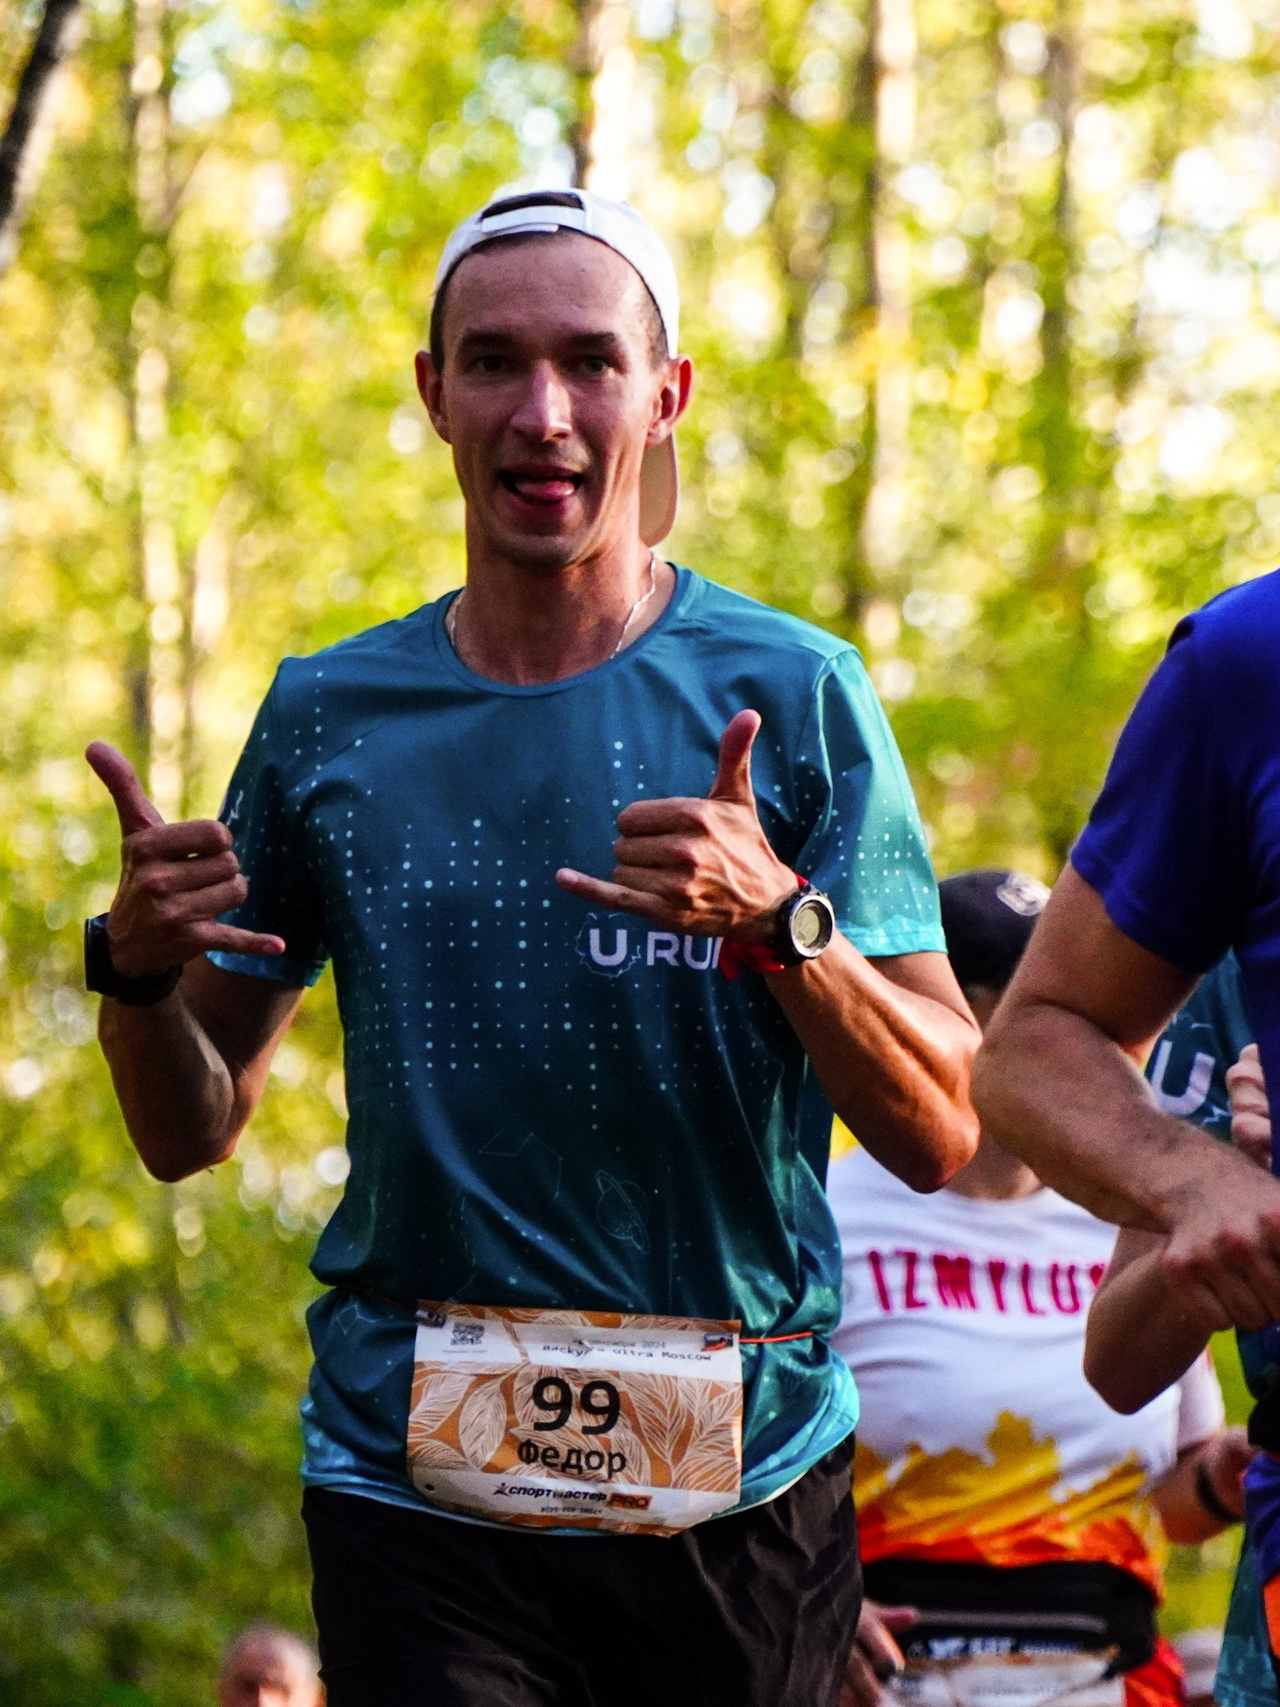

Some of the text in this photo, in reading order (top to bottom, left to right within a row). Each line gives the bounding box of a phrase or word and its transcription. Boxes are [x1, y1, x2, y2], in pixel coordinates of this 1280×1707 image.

[662, 1351, 712, 1362] Moscow
[531, 1376, 621, 1435] 99
[517, 1437, 627, 1482] Федор
